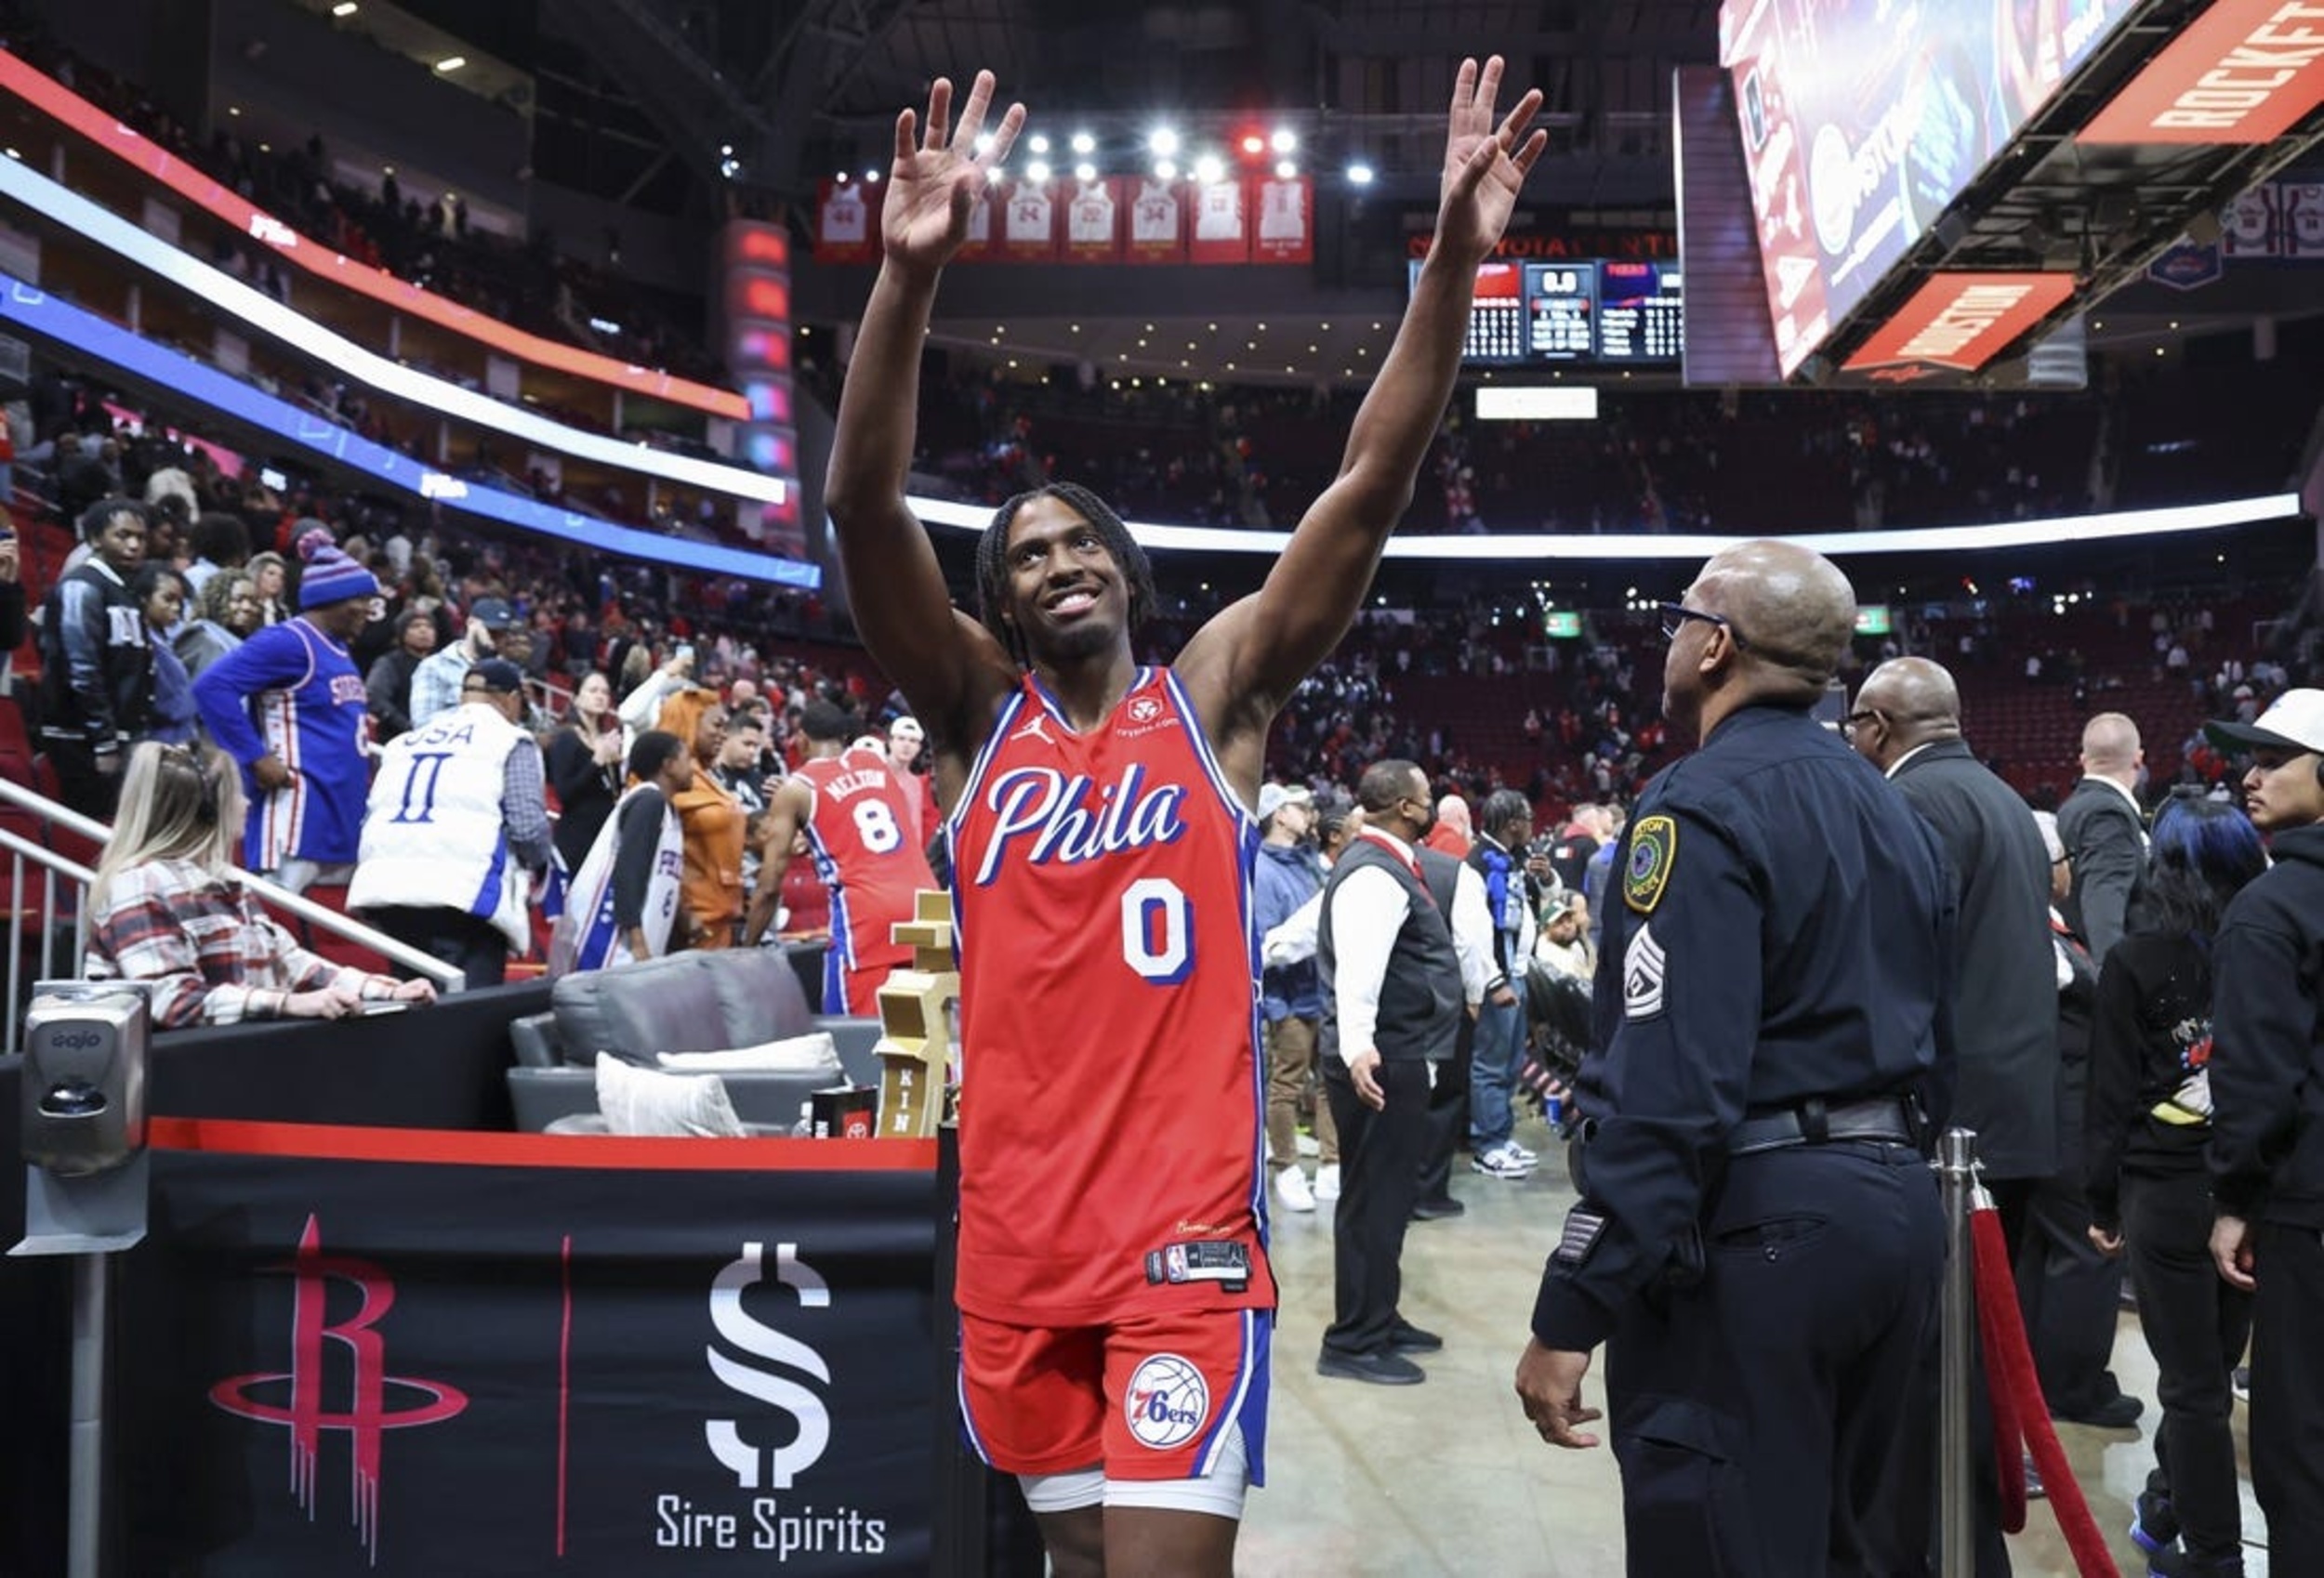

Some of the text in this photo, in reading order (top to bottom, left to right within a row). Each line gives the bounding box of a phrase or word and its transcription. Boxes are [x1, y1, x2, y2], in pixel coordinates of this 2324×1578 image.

[852, 796, 905, 855] 8
[974, 762, 1188, 887] Phila
[1121, 877, 1195, 985] 0
[1133, 1389, 1197, 1425] 76ers
[656, 1494, 886, 1562] Sire Spirits
